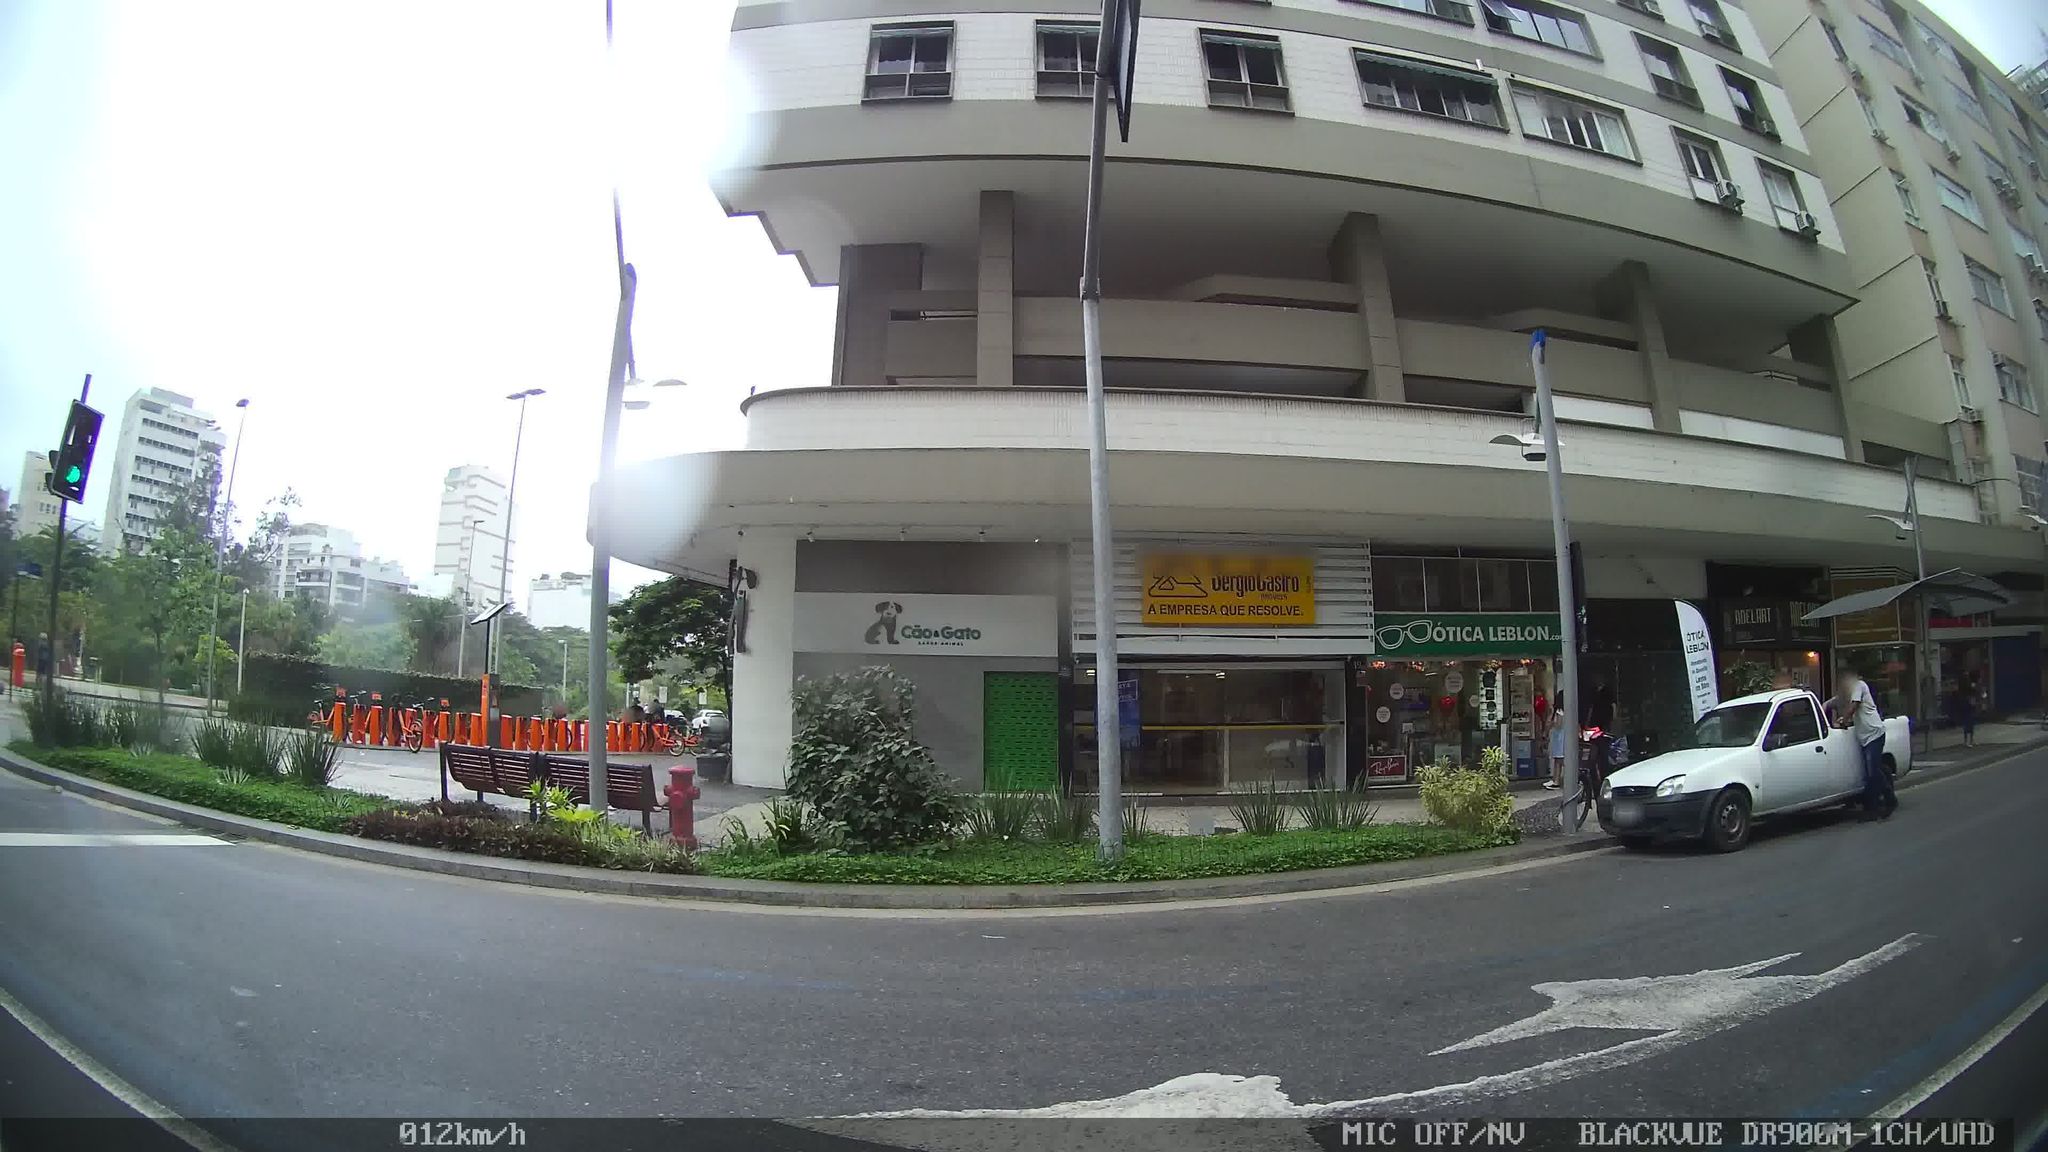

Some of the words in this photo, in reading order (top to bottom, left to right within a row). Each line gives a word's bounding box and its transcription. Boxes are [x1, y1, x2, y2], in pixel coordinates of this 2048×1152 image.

[1148, 605, 1157, 615] A
[1159, 604, 1217, 615] EMPRESA
[1220, 605, 1246, 617] QUE
[1248, 605, 1304, 617] RESOLVE.
[940, 625, 982, 640] Gato
[1432, 622, 1485, 643] ÓTICA
